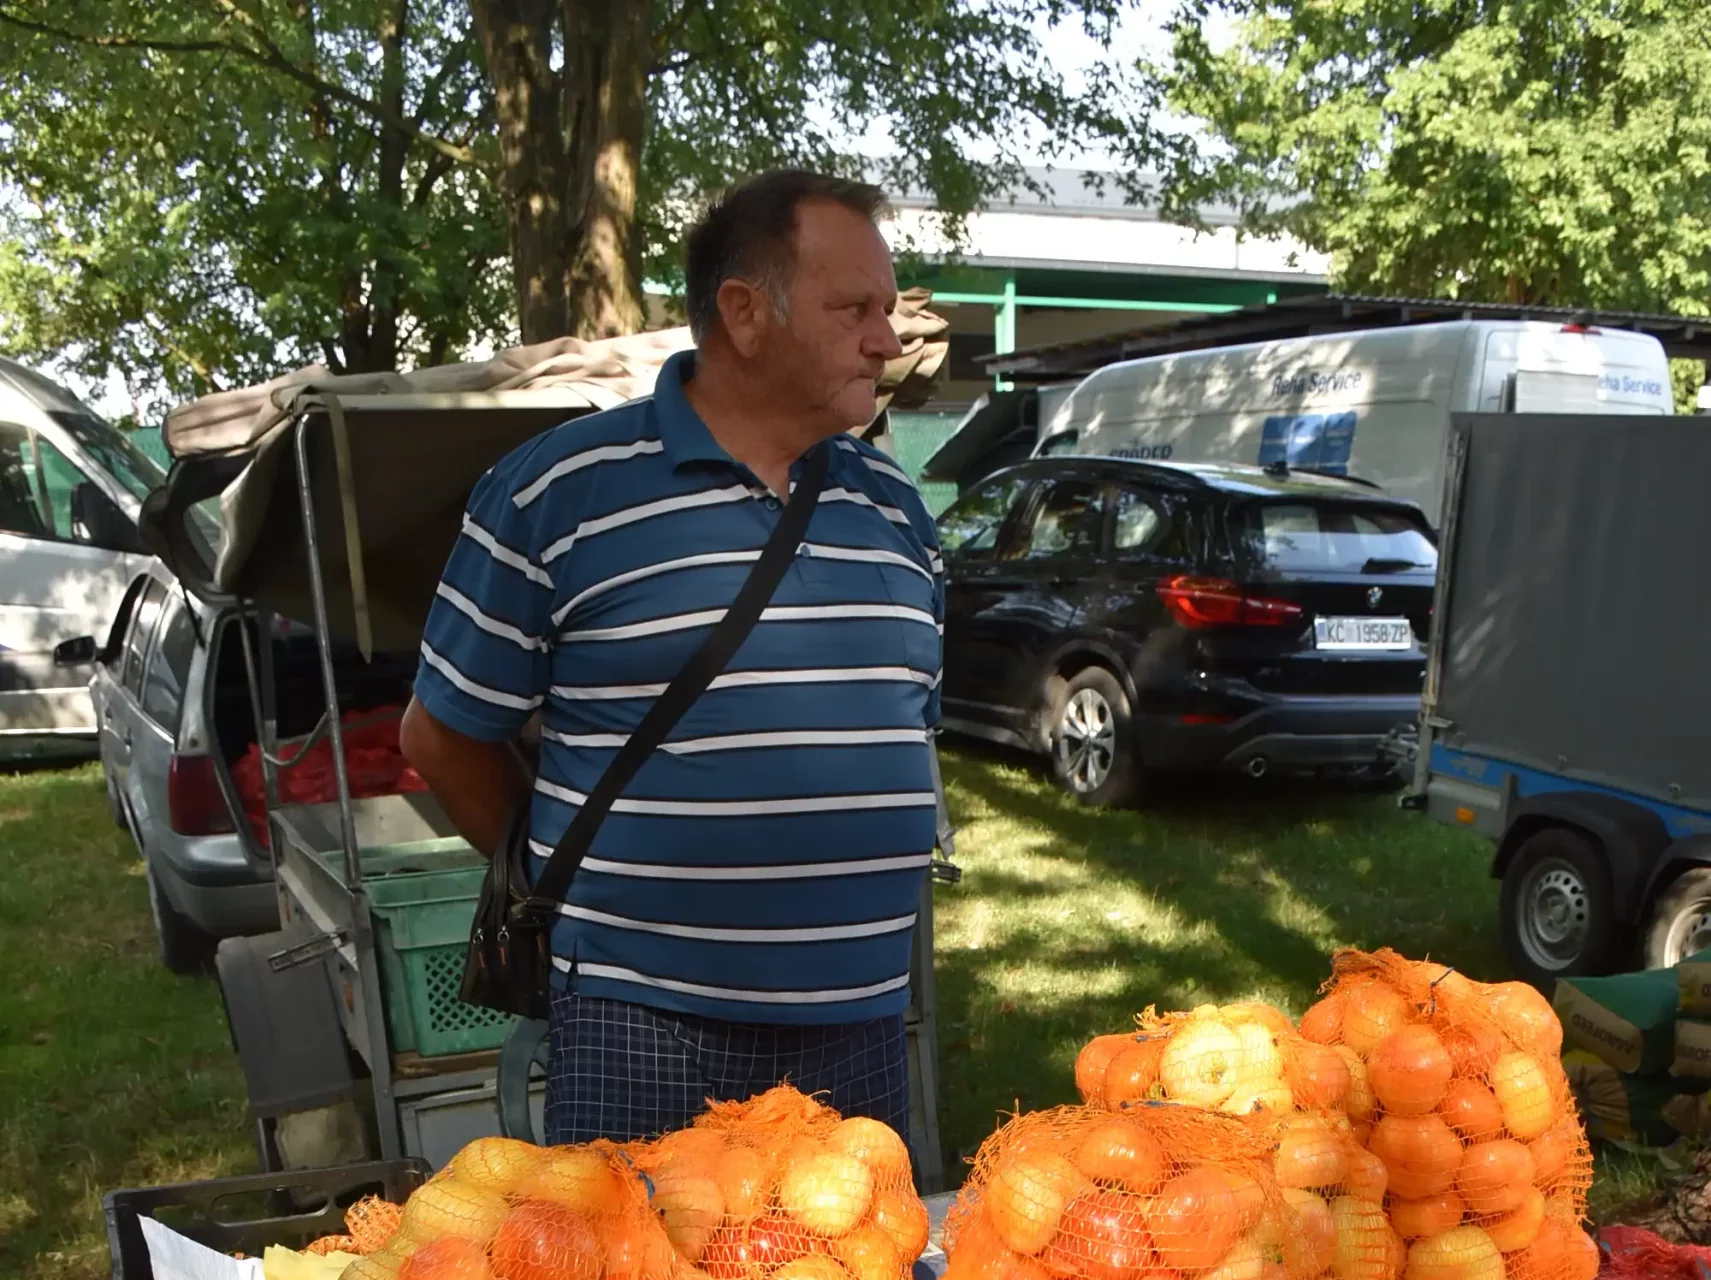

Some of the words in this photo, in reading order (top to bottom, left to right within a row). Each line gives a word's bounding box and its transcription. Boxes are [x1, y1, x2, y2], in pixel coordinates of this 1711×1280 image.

[1308, 371, 1362, 393] Service
[1598, 374, 1620, 392] eha
[1621, 375, 1663, 397] Service
